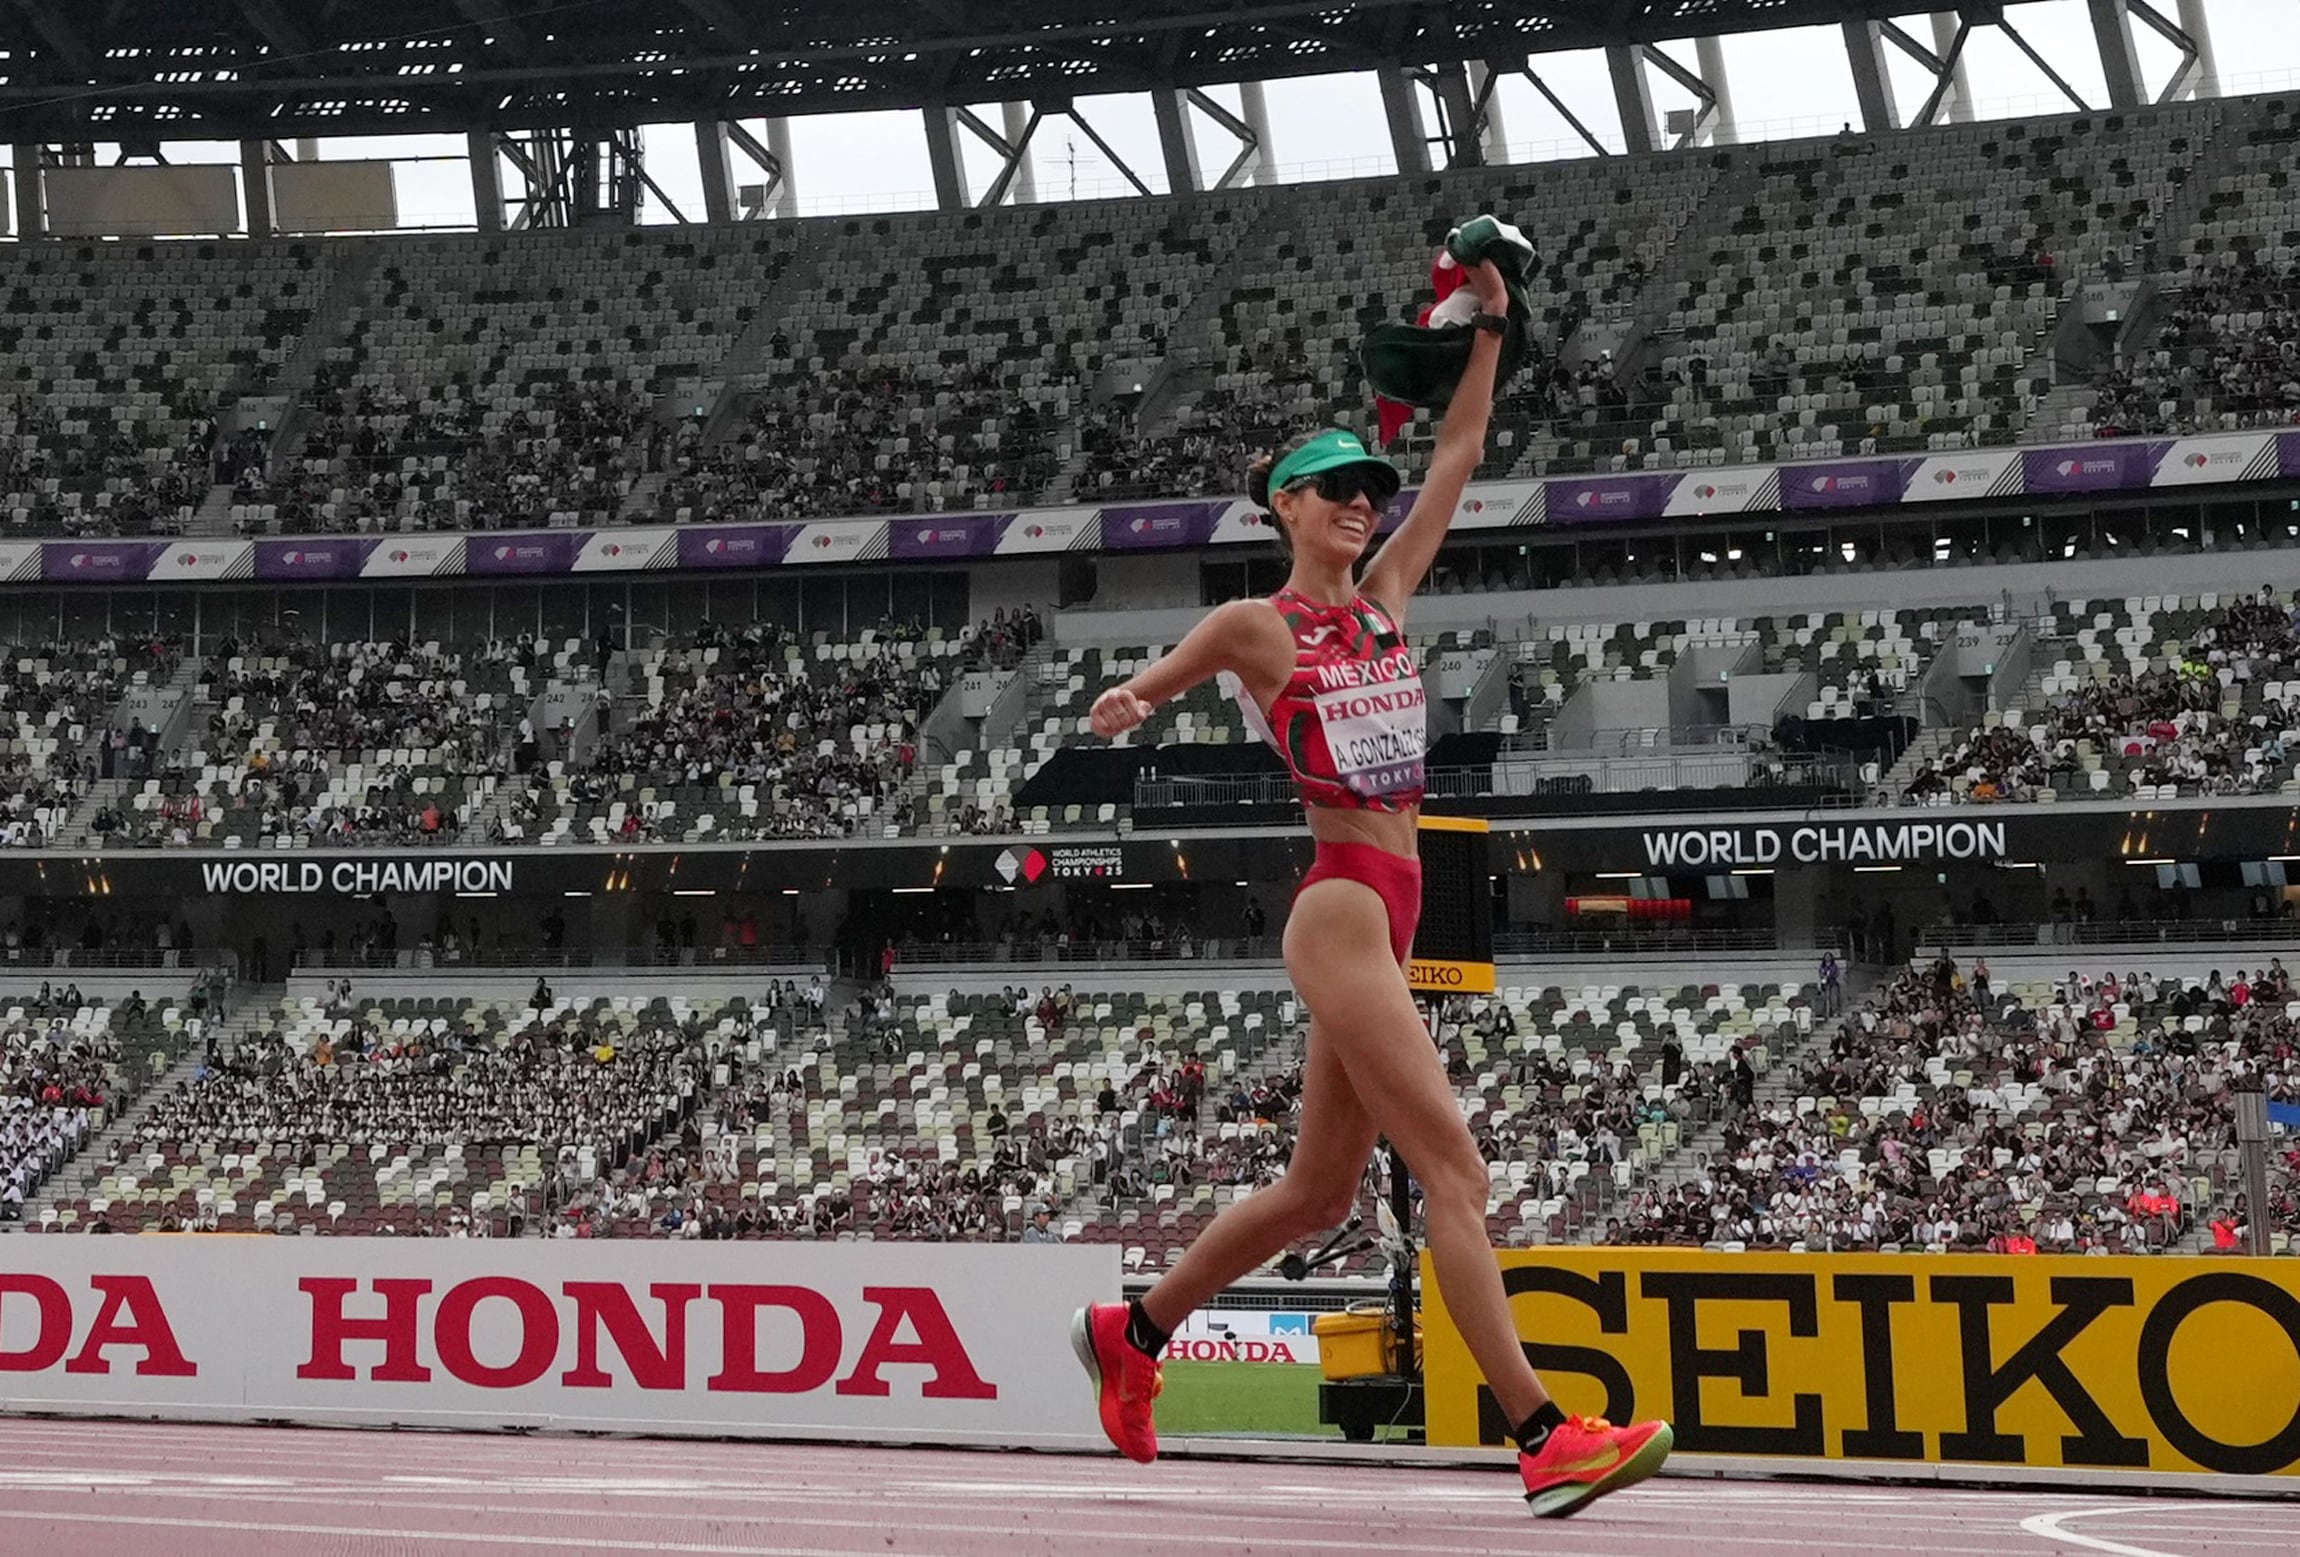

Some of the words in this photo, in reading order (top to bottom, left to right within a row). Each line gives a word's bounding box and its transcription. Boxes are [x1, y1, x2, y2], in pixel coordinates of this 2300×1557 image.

[1957, 636, 1980, 649] 239
[1316, 653, 1413, 689] MÉXICO
[1440, 661, 1462, 672] 240
[963, 681, 982, 691] 241
[129, 699, 148, 710] 243
[547, 694, 565, 704] 242
[1323, 688, 1425, 722] HONDA
[1335, 743, 1351, 770] A.
[1052, 848, 1080, 857] WORLD
[1081, 847, 1122, 857] ATHLETICS
[1643, 829, 1781, 865] WORLD
[1791, 822, 2006, 862] CHAMPION
[1052, 857, 1122, 867] CHAMPIONSHIPS
[202, 862, 323, 893] WORLD
[331, 861, 513, 893] CHAMPION
[0, 1273, 197, 1376] DA
[297, 1276, 998, 1400] HONDA
[1166, 1340, 1297, 1363] HONDA
[1477, 1265, 2300, 1475] SEIKO
